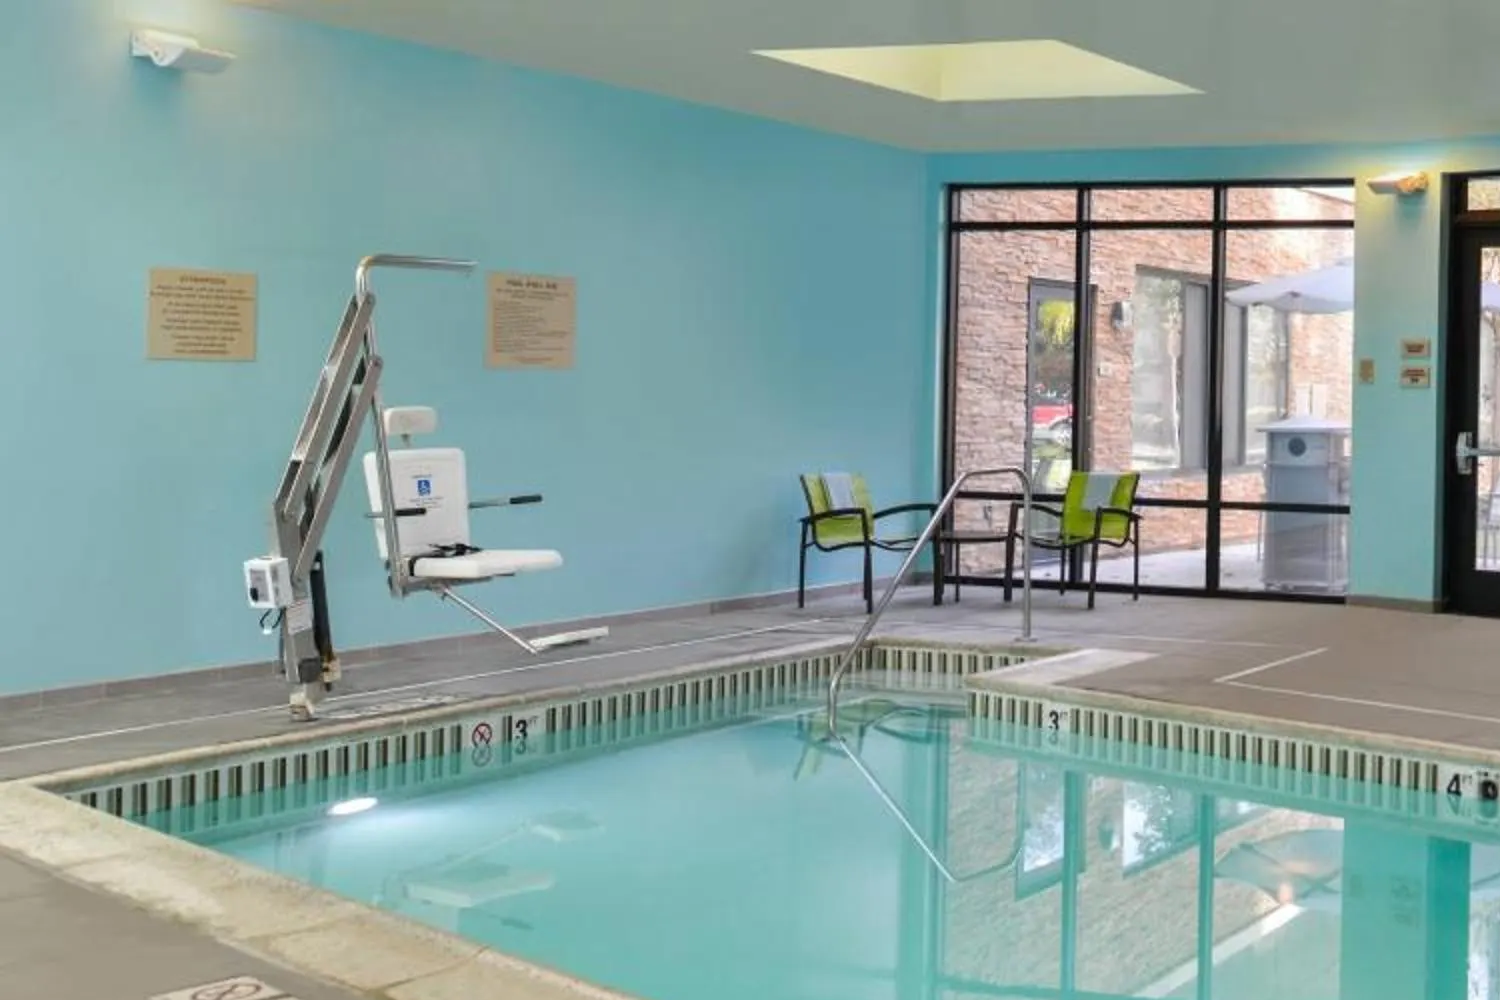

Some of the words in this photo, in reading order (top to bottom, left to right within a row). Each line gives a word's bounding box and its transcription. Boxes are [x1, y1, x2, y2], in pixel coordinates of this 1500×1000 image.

[515, 719, 528, 741] 3
[1049, 709, 1059, 731] 3
[1447, 773, 1462, 796] 4
